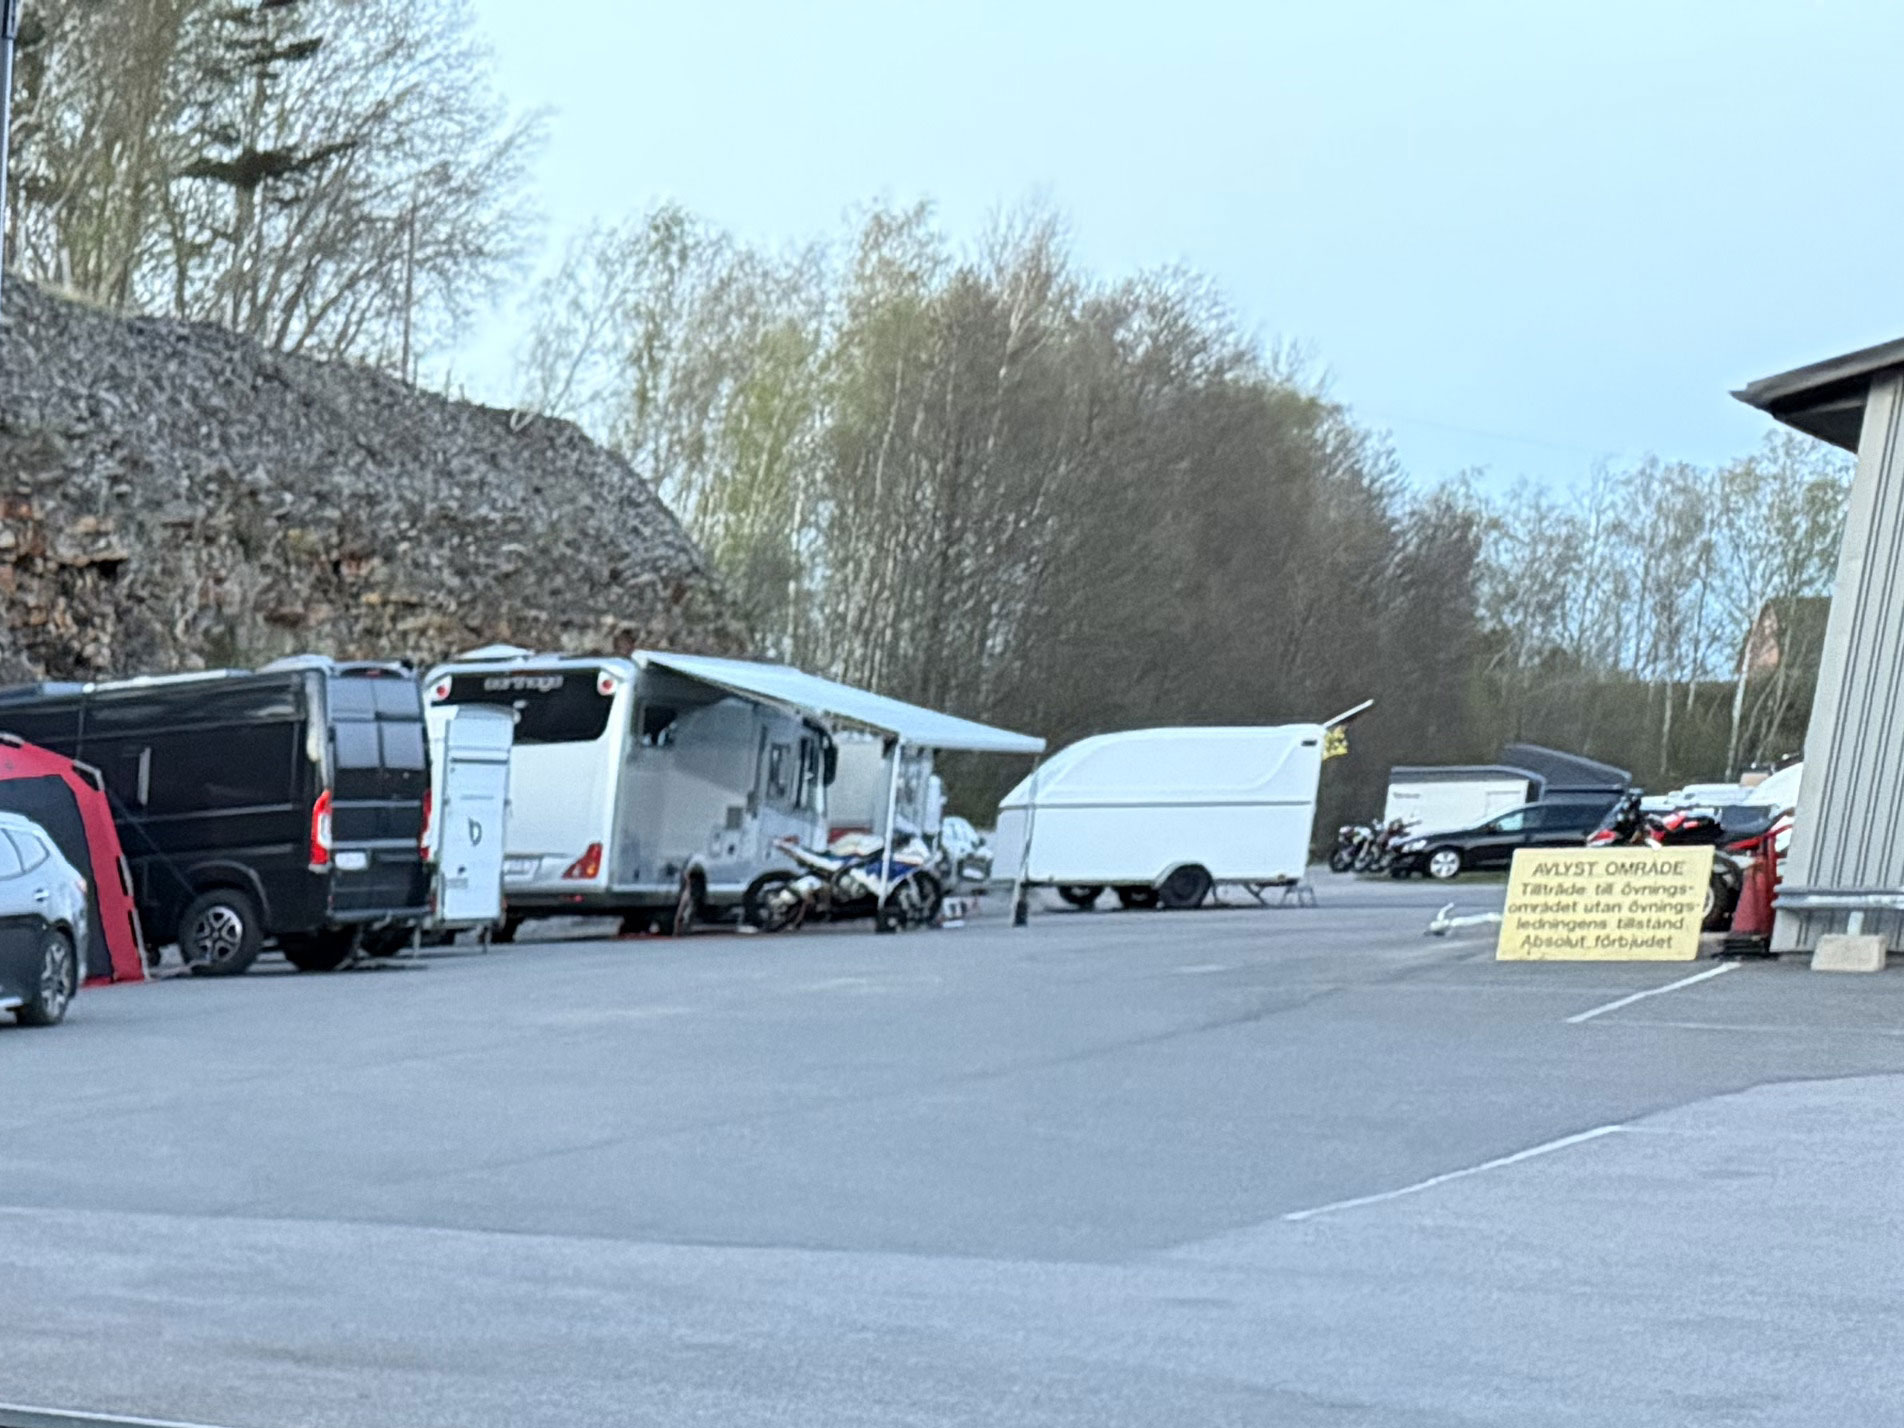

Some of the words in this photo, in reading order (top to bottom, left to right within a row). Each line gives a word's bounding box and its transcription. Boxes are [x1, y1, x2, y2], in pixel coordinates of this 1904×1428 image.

[1531, 861, 1599, 877] AVLYST
[1595, 882, 1614, 896] till
[1583, 899, 1622, 913] utan
[1516, 917, 1608, 932] ledningens
